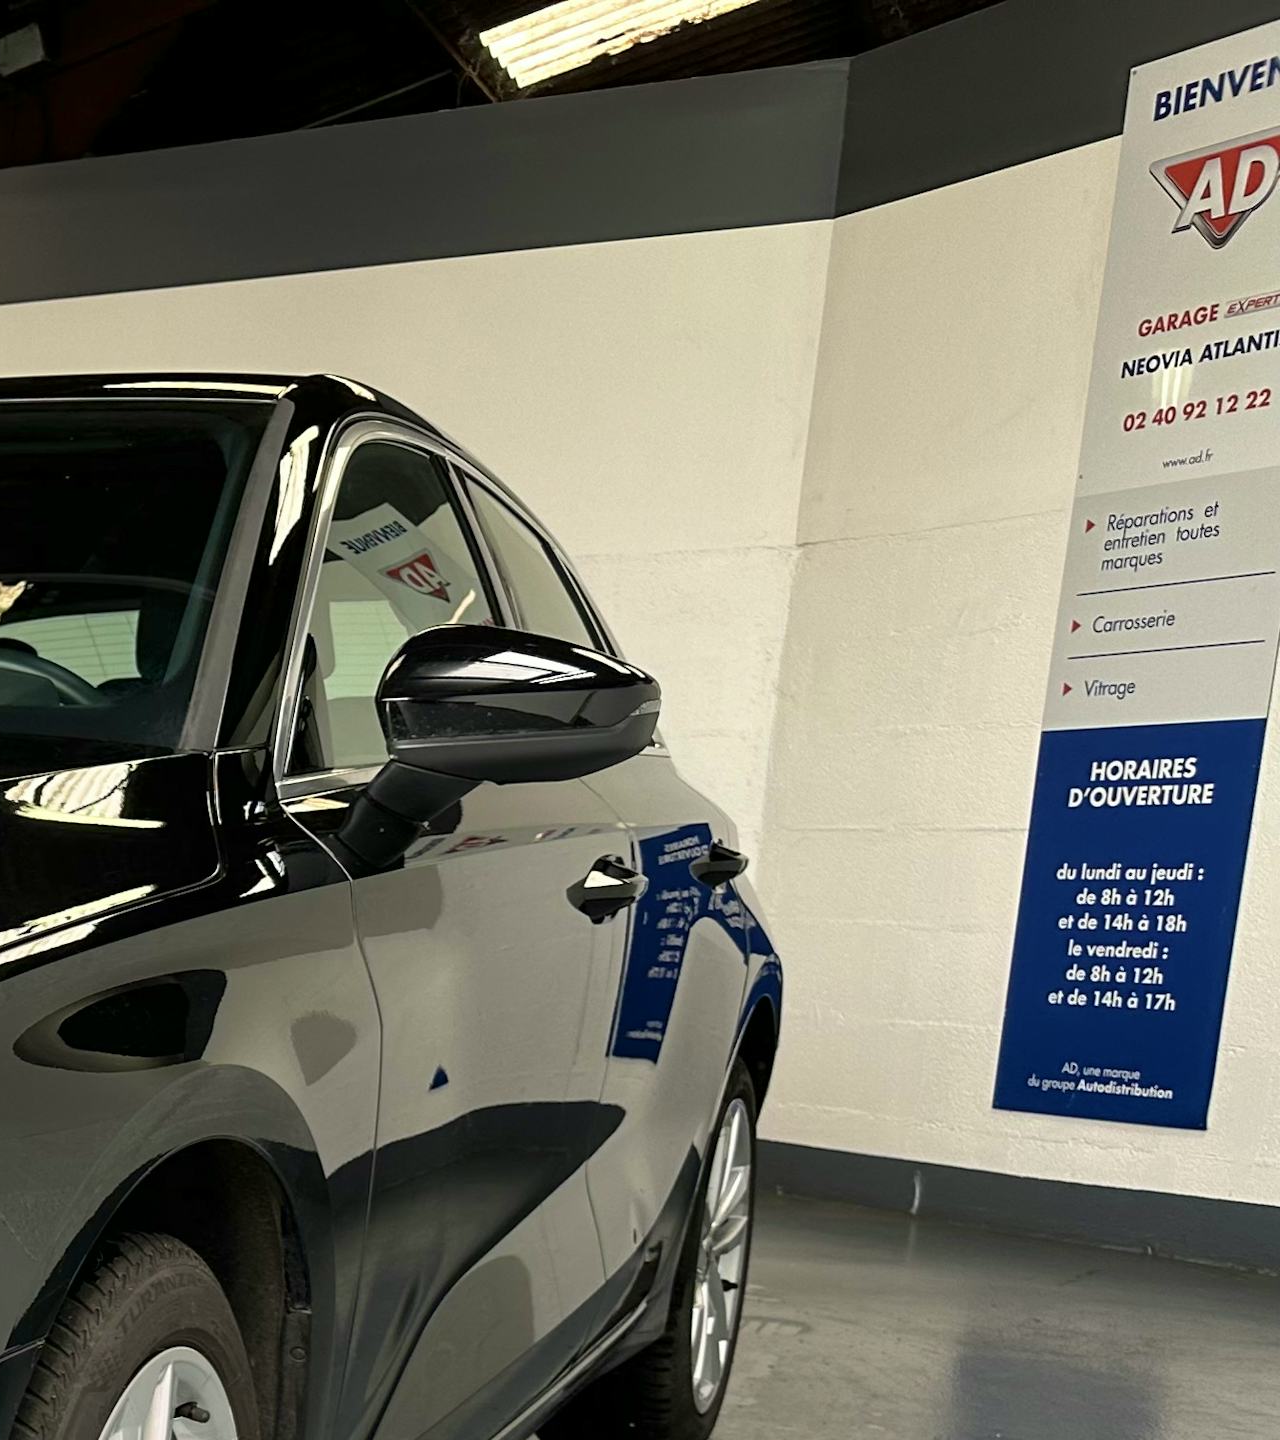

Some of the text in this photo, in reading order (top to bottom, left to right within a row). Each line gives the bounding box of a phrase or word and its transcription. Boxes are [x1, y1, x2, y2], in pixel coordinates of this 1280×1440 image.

[1171, 144, 1280, 233] AD
[1138, 304, 1220, 337] GARAGE
[1121, 348, 1193, 378] NEOVIA
[1123, 388, 1271, 432] 02 40 92 12 22
[1162, 449, 1213, 468] www.ad.fr
[1107, 501, 1219, 538] Réparations et
[1104, 523, 1220, 551] entretien toutes
[1101, 552, 1163, 572] marques
[1093, 609, 1175, 633] Carrosserie
[1085, 680, 1135, 700] Vitrage
[1090, 757, 1197, 781] HORAIRES
[1068, 784, 1214, 807] D'OUVERTURE
[1056, 863, 1077, 880] du
[1081, 863, 1122, 880] lundi
[1125, 868, 1147, 880] au
[1150, 863, 1194, 885] jeudi
[1076, 888, 1175, 906] de 8h à 12h
[1058, 913, 1187, 932] et de 14h à 18h
[1068, 939, 1082, 956] le
[1086, 941, 1159, 959] vendredi
[1066, 964, 1164, 984] de 8h à 12h
[1048, 988, 1176, 1011] et de 14h à 17h
[1061, 1062, 1140, 1082] AD, une marque
[1028, 1073, 1174, 1099] du groupe Autodistribution
